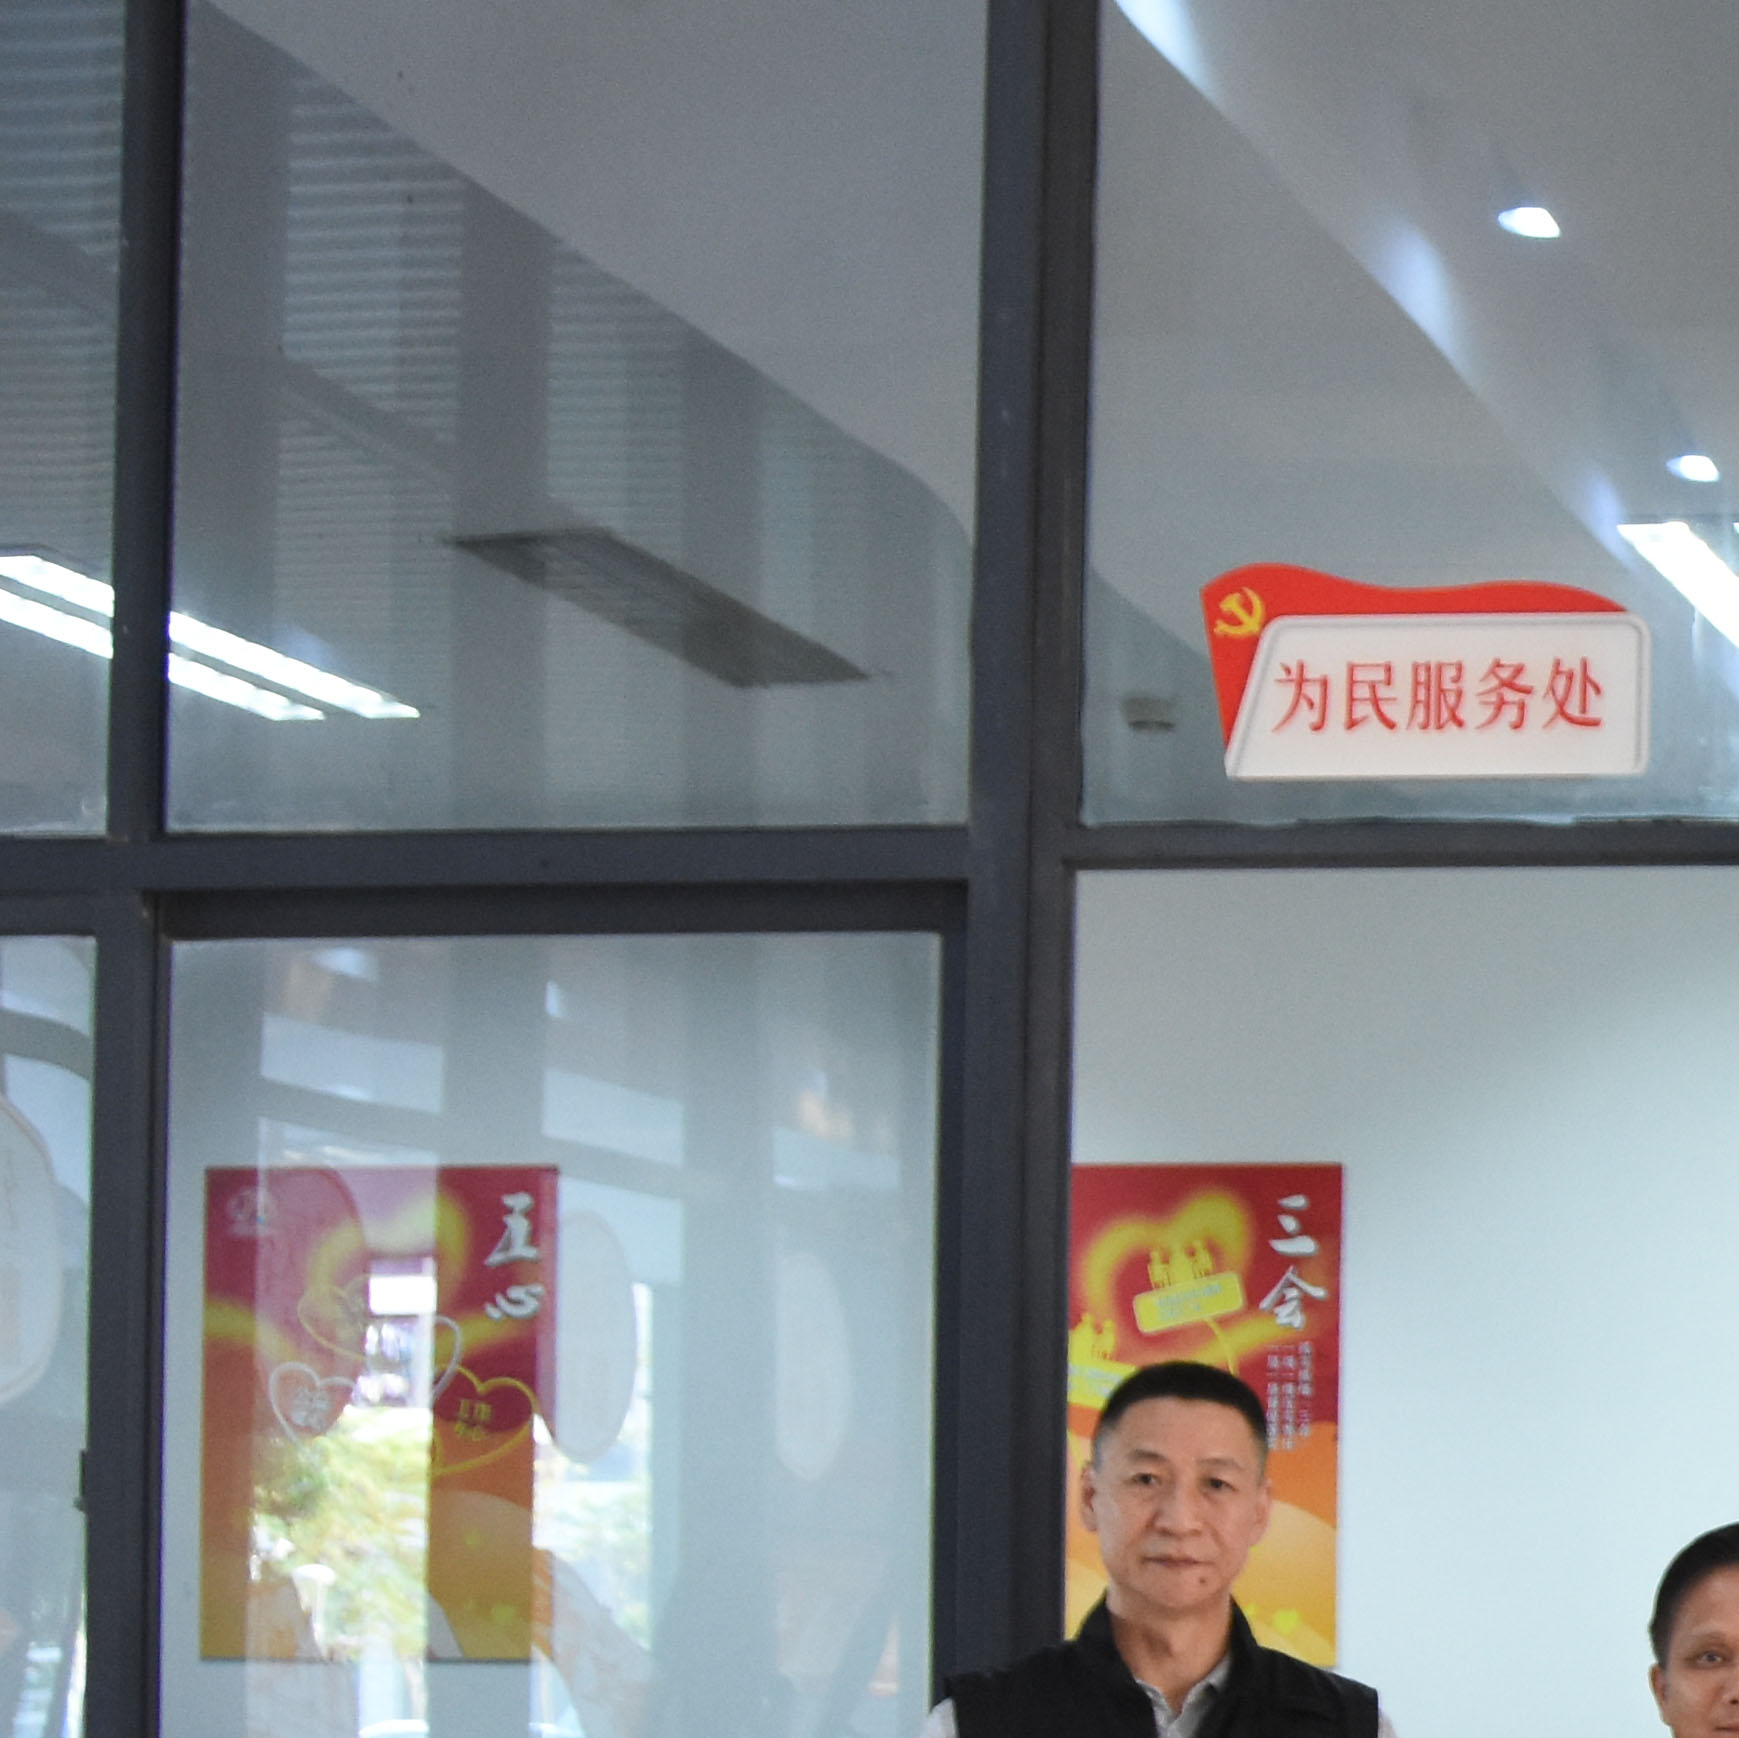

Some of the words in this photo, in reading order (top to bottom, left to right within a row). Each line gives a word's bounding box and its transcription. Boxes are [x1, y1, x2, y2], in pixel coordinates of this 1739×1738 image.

[1271, 655, 1605, 735] 为民服务处
[1259, 1193, 1330, 1330] 三会
